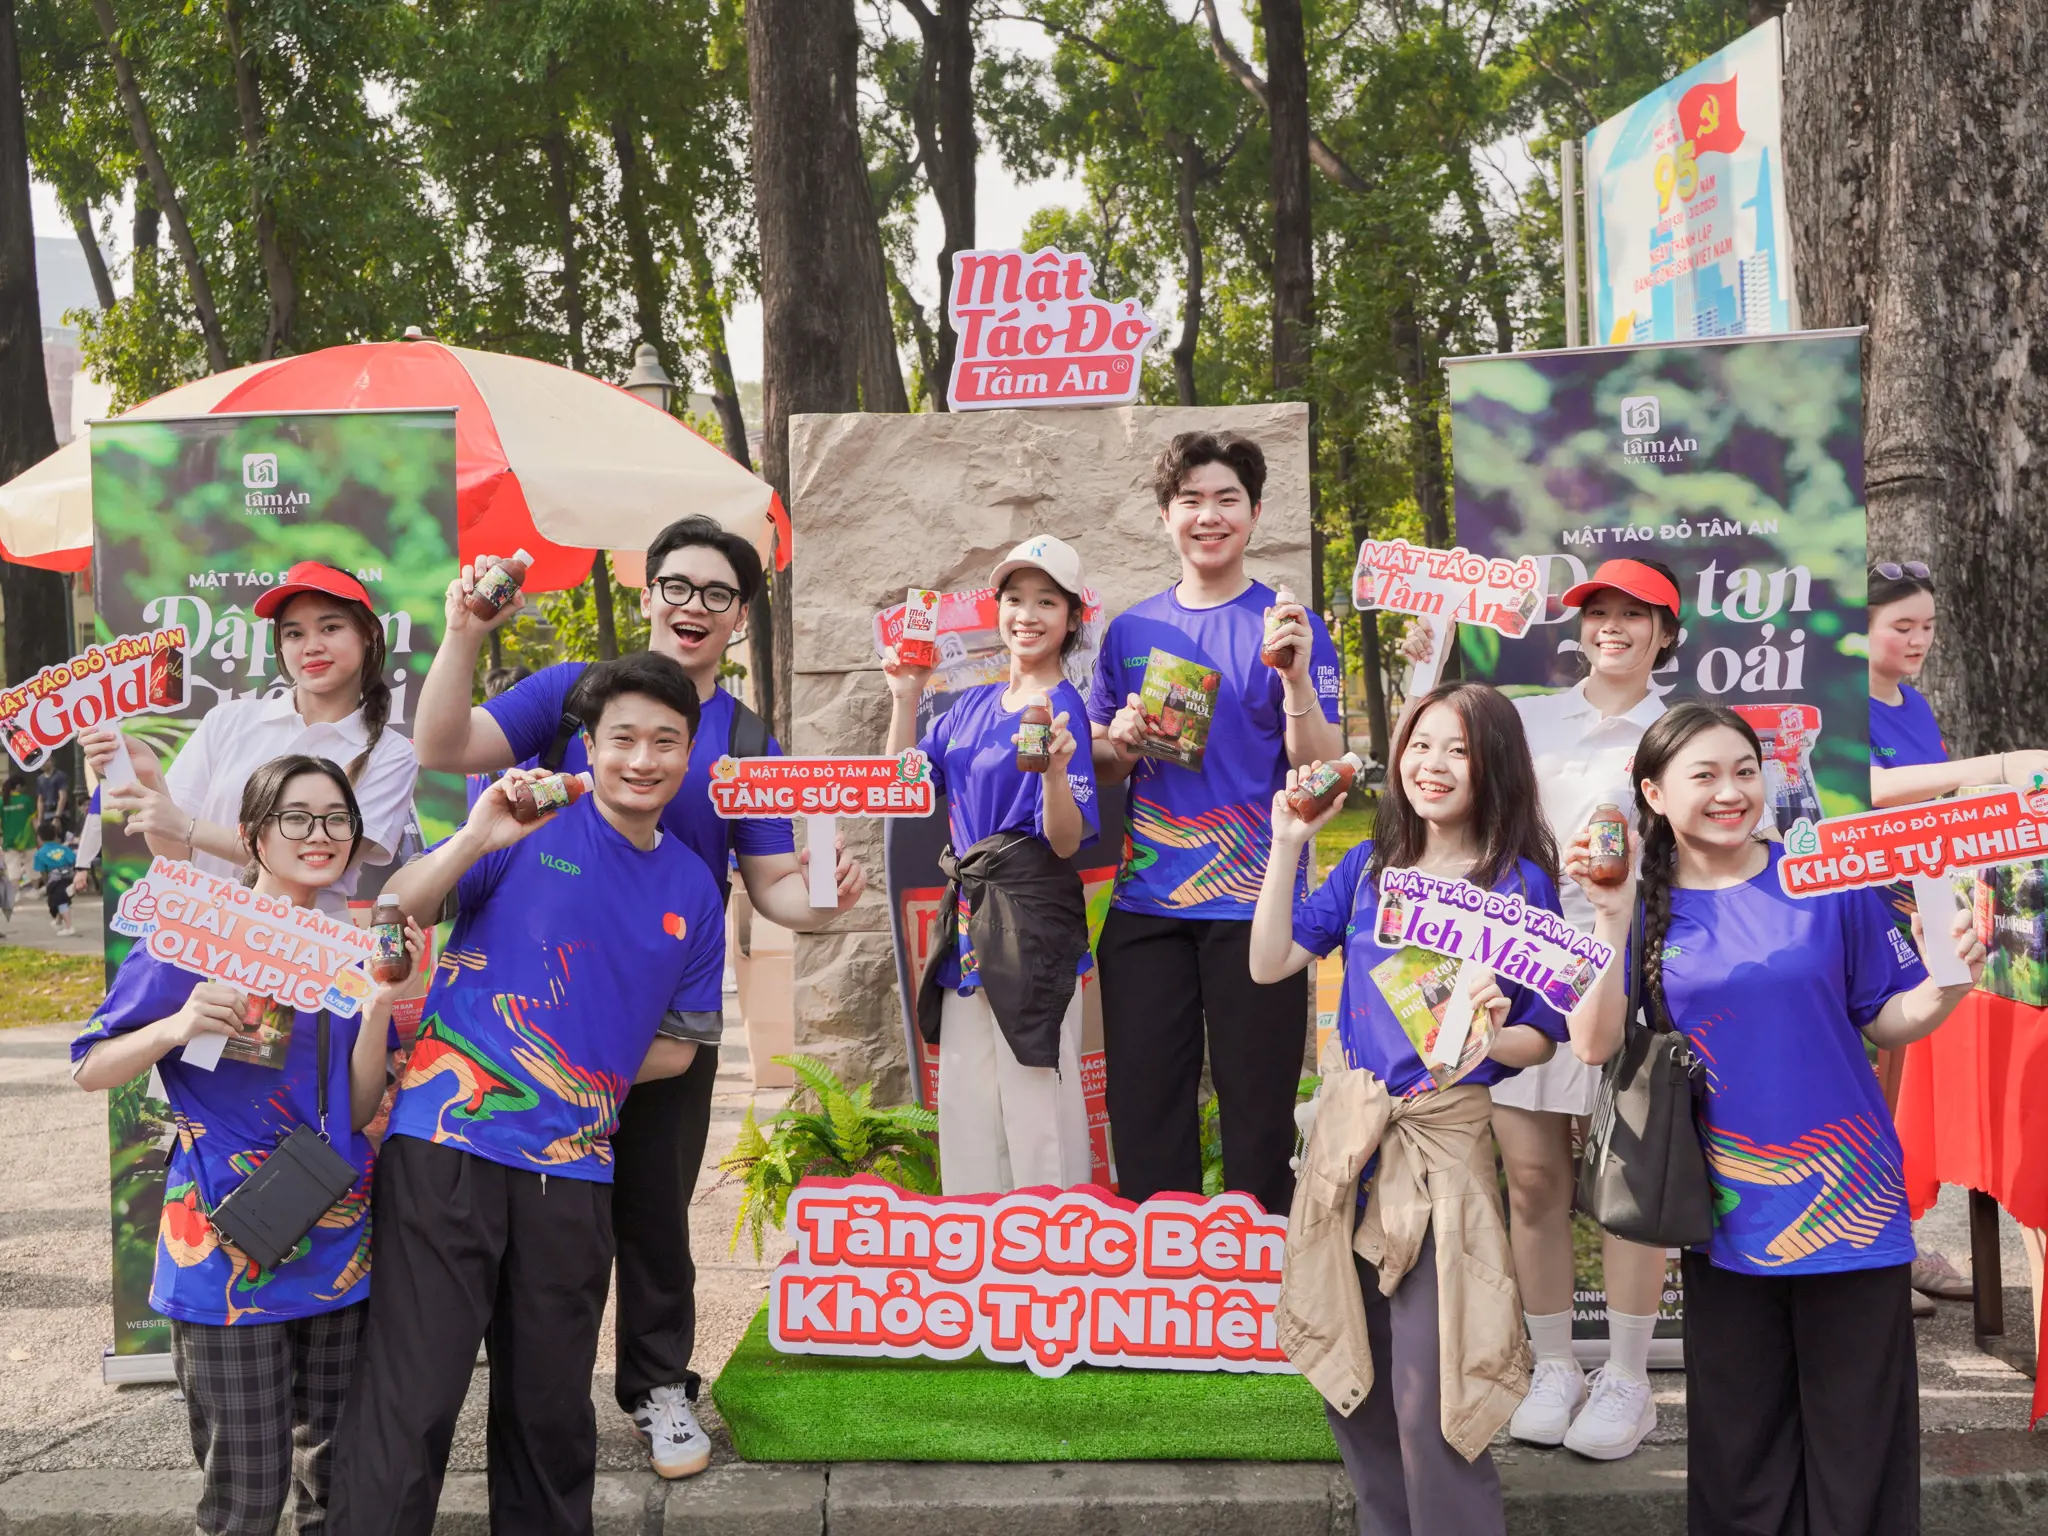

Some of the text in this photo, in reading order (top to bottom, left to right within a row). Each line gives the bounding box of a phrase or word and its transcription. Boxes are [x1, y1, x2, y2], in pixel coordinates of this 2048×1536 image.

[956, 253, 1088, 313] Mật
[972, 366, 1049, 396] Tâm
[1057, 364, 1109, 393] An
[1623, 454, 1683, 465] NATURAL
[245, 506, 298, 517] NATURAL
[1562, 518, 1779, 548] MẬT TÁO ĐỎ TÂM AN
[189, 568, 231, 591] MẬT
[234, 568, 273, 588] TÁO
[357, 567, 383, 583] AN
[1363, 542, 1425, 576] MẬT
[1427, 552, 1485, 584] TÁO
[1488, 560, 1536, 589] ĐỎ
[1696, 558, 1812, 624] tan
[1375, 573, 1444, 615] Tâm
[1453, 588, 1504, 624] An
[28, 668, 71, 700] TÁO
[72, 648, 106, 681] ĐỎ
[105, 636, 150, 666] TÂM
[153, 628, 185, 651] AN
[1696, 623, 1807, 694] oải
[30, 664, 149, 746] Gold
[717, 779, 924, 808] TĂNG SỨC BỀN
[750, 763, 891, 779] MẬT TÁO ĐỎ TÂM AN
[1831, 803, 2008, 844] MẬT TÁO ĐỎ TÂM AN
[540, 852, 582, 876] VLOOP
[1789, 846, 1889, 886] KHỎE
[1894, 834, 1943, 869] TỰ
[113, 915, 157, 933] Tâm An
[154, 858, 377, 951] MẬT TÁO ĐỎ TÂM AN
[1385, 871, 1612, 969] MẬT TÁO ĐỎ TÂM AN
[157, 893, 349, 977] GIẢI CHẠY
[1404, 898, 1555, 991] Ích Mẫu
[154, 929, 324, 1006] OLYMPIC
[804, 1204, 1288, 1273] Tăng Sức Bền
[787, 1273, 968, 1338] Khỏe
[986, 1291, 1079, 1357] Tự
